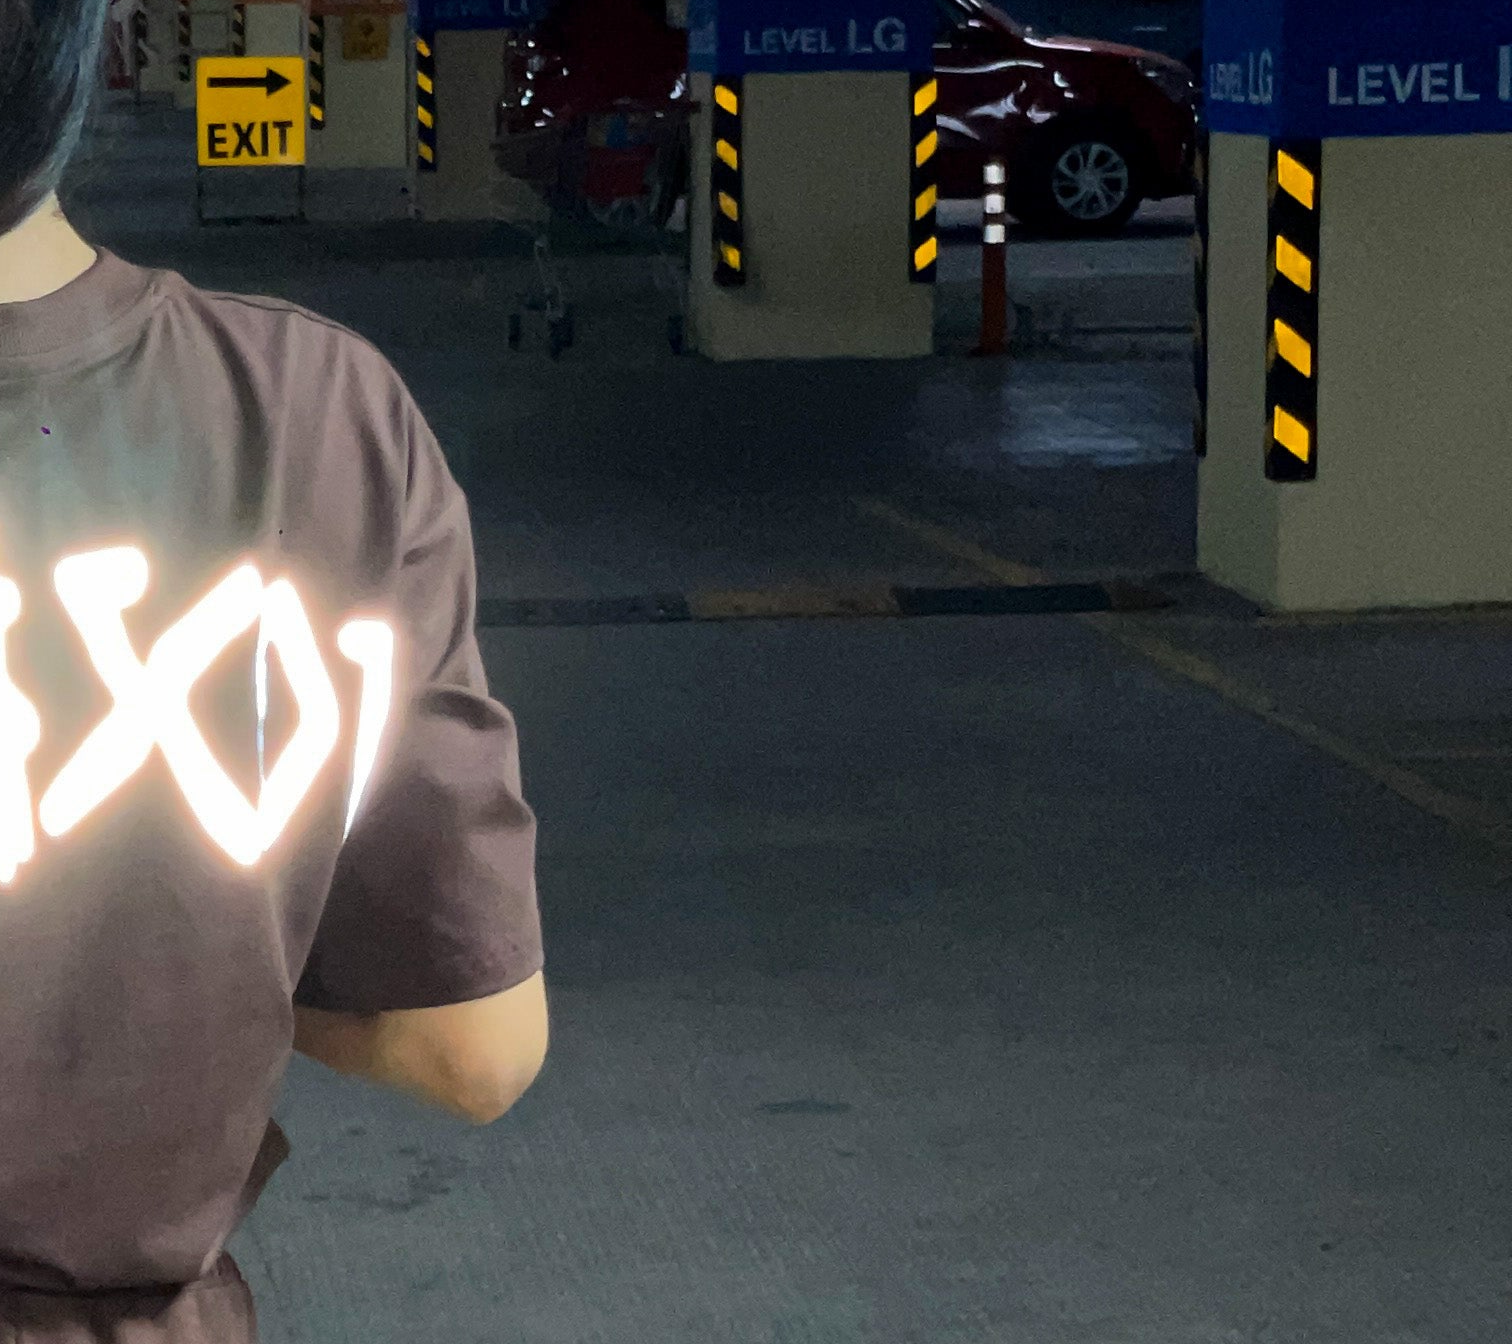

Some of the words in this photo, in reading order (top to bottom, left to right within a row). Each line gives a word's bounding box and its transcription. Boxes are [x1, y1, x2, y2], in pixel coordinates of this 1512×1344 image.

[743, 27, 837, 55] LEVEL
[847, 16, 907, 54] LG
[1248, 48, 1273, 106] LG
[1327, 61, 1481, 107] LEVEL
[207, 120, 293, 159] EXIT
